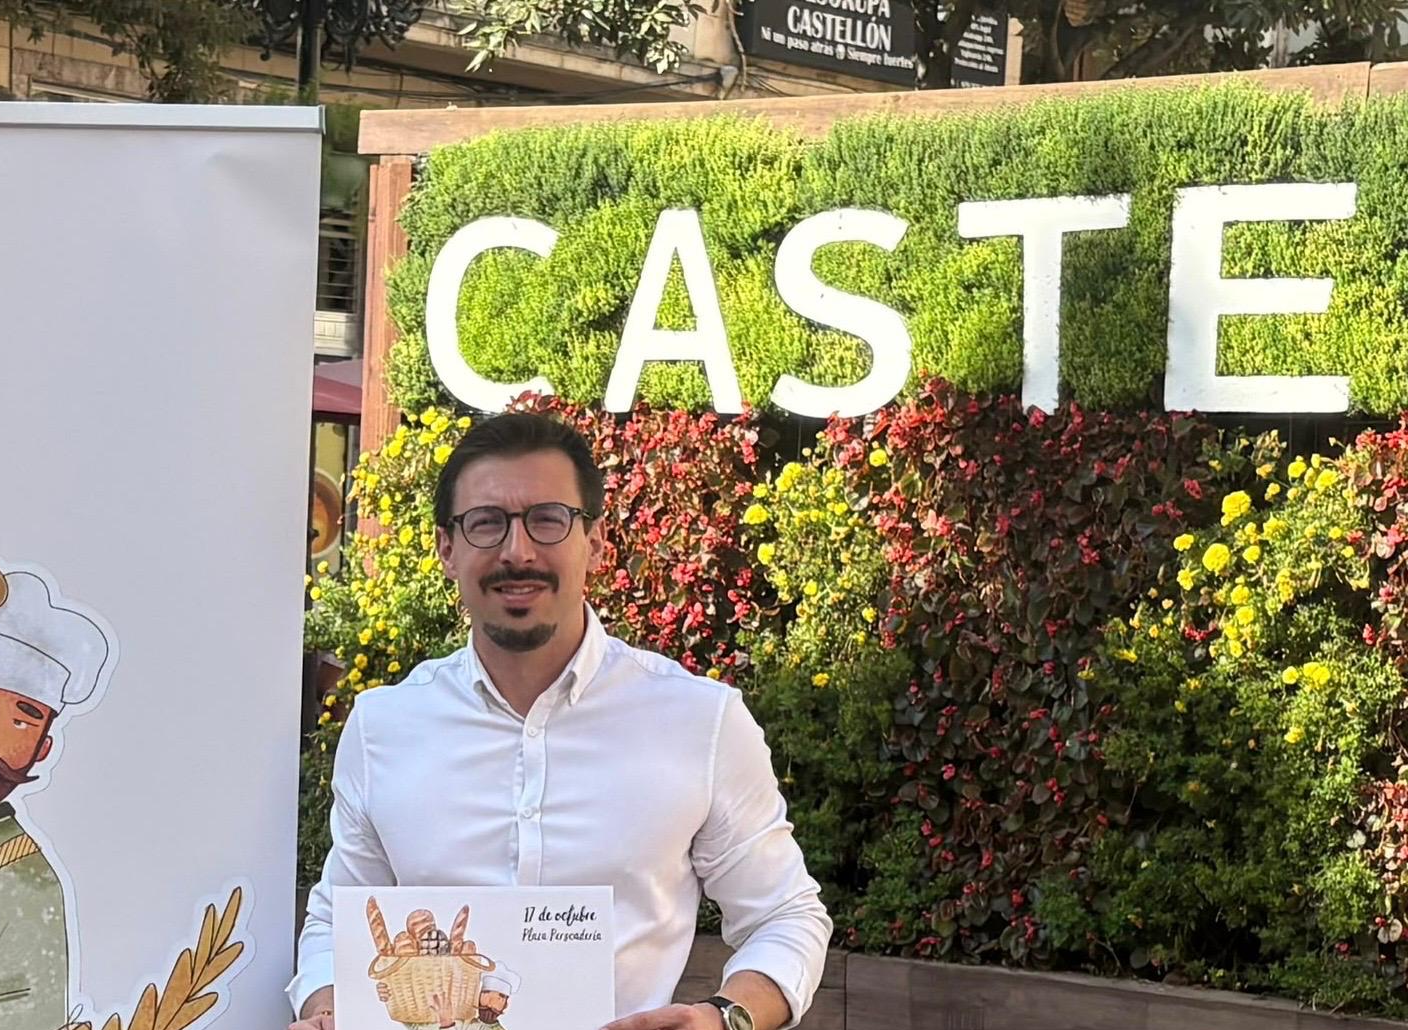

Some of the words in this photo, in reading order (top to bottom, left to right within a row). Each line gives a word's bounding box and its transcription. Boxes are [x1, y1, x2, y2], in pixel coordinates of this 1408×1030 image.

[787, 6, 891, 52] CASTELLÓN
[426, 183, 1358, 419] CASTE
[524, 906, 536, 923] 17
[538, 906, 552, 921] de
[554, 904, 597, 926] octubre
